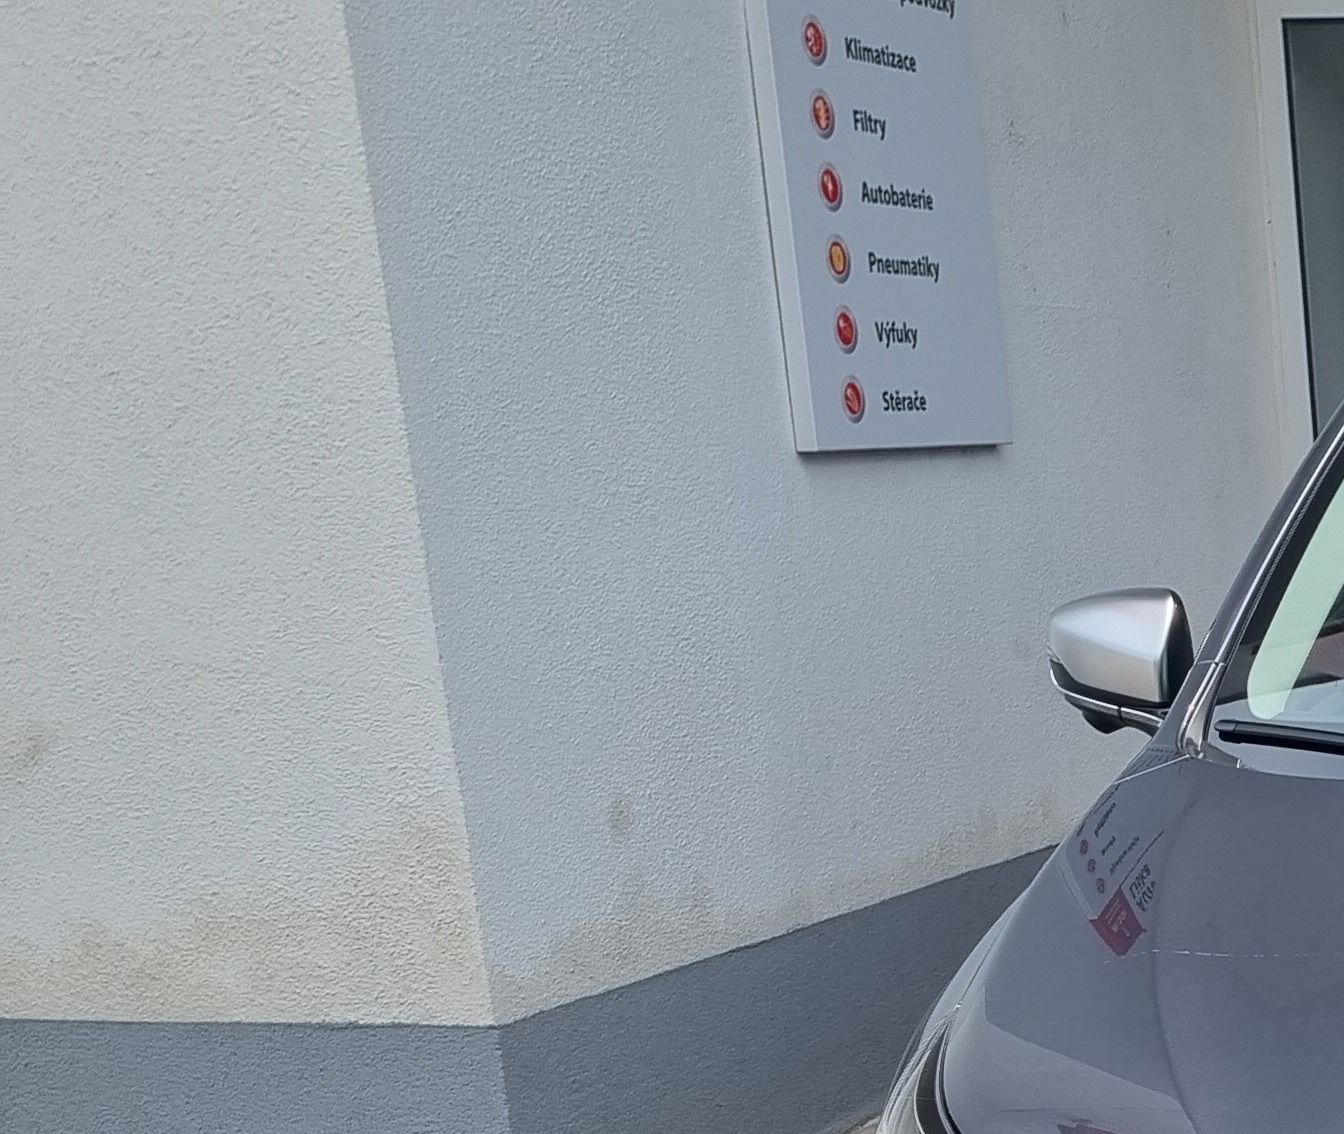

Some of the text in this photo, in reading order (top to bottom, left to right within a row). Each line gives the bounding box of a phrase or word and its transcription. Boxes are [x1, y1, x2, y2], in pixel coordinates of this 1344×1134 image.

[844, 36, 917, 73] Klimatizace
[852, 109, 887, 141] Filtry
[861, 180, 934, 211] Autobaterie
[867, 251, 940, 284] Pneumatiky
[874, 320, 918, 350] Výfuky
[881, 389, 927, 412] Stěrače
